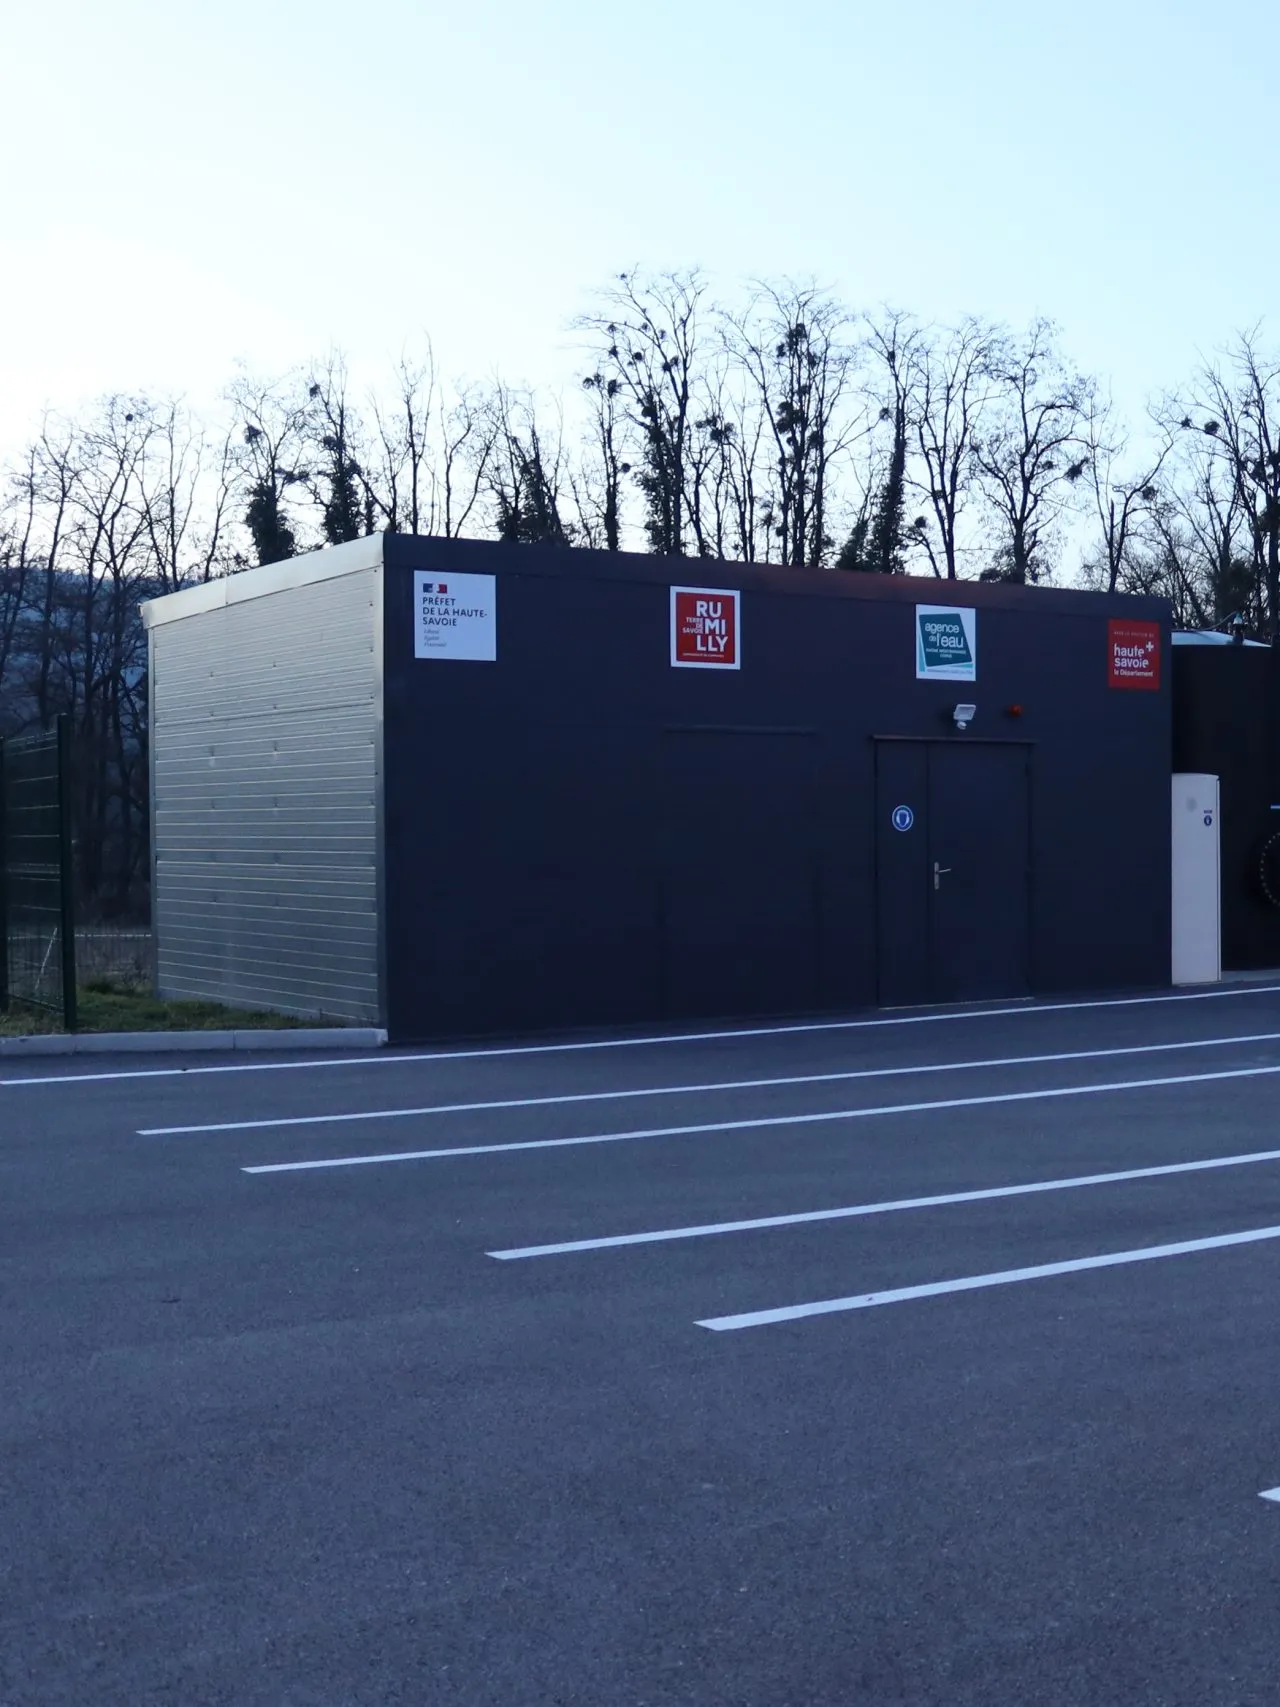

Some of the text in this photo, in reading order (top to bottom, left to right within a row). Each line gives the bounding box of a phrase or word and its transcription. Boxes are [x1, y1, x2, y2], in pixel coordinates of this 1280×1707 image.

[422, 596, 456, 606] PRÉFET
[422, 606, 488, 618] DE LA HAUTE-
[696, 600, 722, 618] RU
[422, 617, 457, 627] SAVOIE
[704, 618, 726, 636] MI
[925, 622, 960, 634] agence
[696, 635, 728, 652] LLY
[936, 633, 964, 648] l'eau
[1113, 642, 1145, 658] haute
[1114, 658, 1149, 668] savoie
